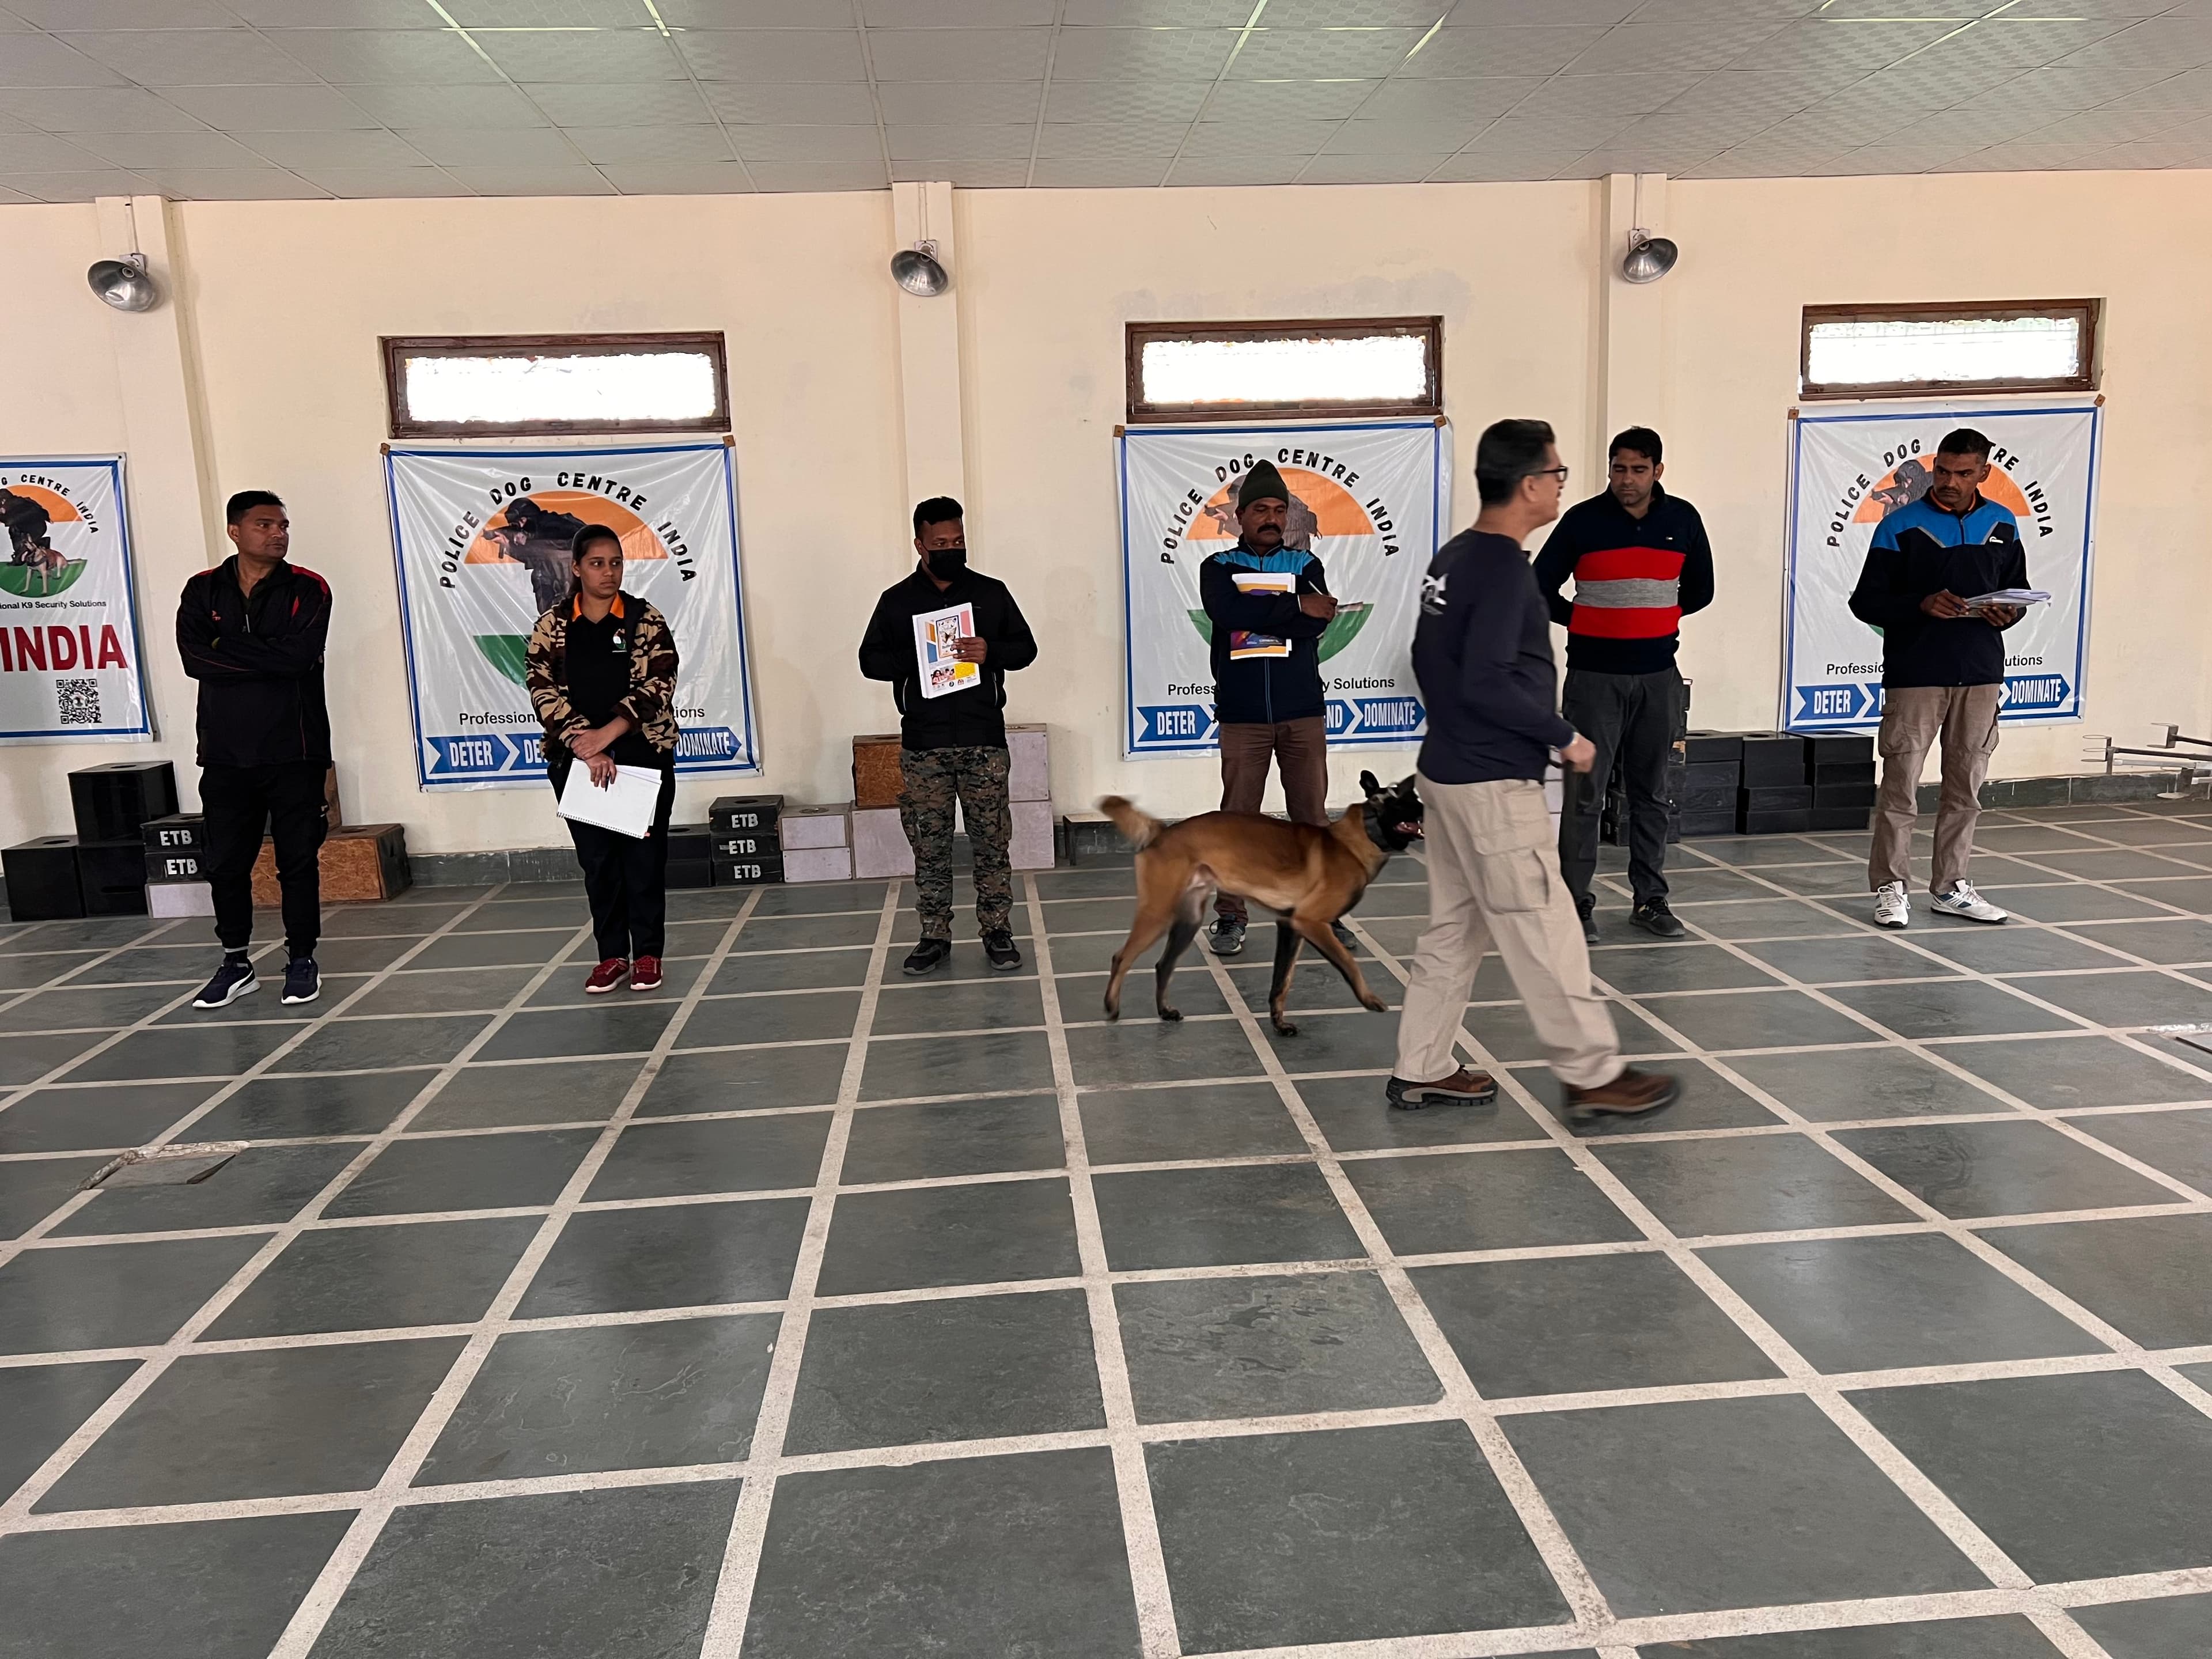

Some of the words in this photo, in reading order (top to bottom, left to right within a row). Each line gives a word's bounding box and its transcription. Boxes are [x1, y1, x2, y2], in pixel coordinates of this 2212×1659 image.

[21, 474, 70, 496] CENTRE
[76, 501, 99, 533] INDIA
[1827, 474, 1870, 548] POLICE
[1884, 439, 1921, 467] DOG
[2024, 480, 2054, 537] INDIA
[1161, 488, 1203, 565] POLICE
[1215, 453, 1255, 483] DOG
[1278, 448, 1360, 488] CENTRE
[1366, 497, 1400, 556] INDIA
[440, 511, 480, 588] POLICE
[489, 477, 532, 505] DOG
[557, 472, 647, 512] CENTRE
[657, 521, 698, 582] INDIA
[36, 601, 67, 609] Security
[69, 600, 107, 608] Solutions
[0, 624, 128, 672] INDIA
[1827, 662, 1884, 675] Professio
[2005, 654, 2043, 666] utions
[1168, 683, 1215, 696] Profess
[1334, 677, 1395, 690] Solutions
[1813, 690, 1851, 714] DETER
[2011, 679, 2062, 704] DOMINATE
[459, 711, 536, 725] Profession
[1157, 710, 1196, 736] DETER
[1364, 702, 1416, 727] DOMINATE
[449, 740, 494, 767] DETER
[676, 732, 732, 757] DOMINATE
[732, 813, 759, 828] ETB
[160, 830, 192, 846] ETB
[729, 839, 756, 854] ETB
[166, 859, 198, 875] ETB
[734, 865, 761, 878] ETB
